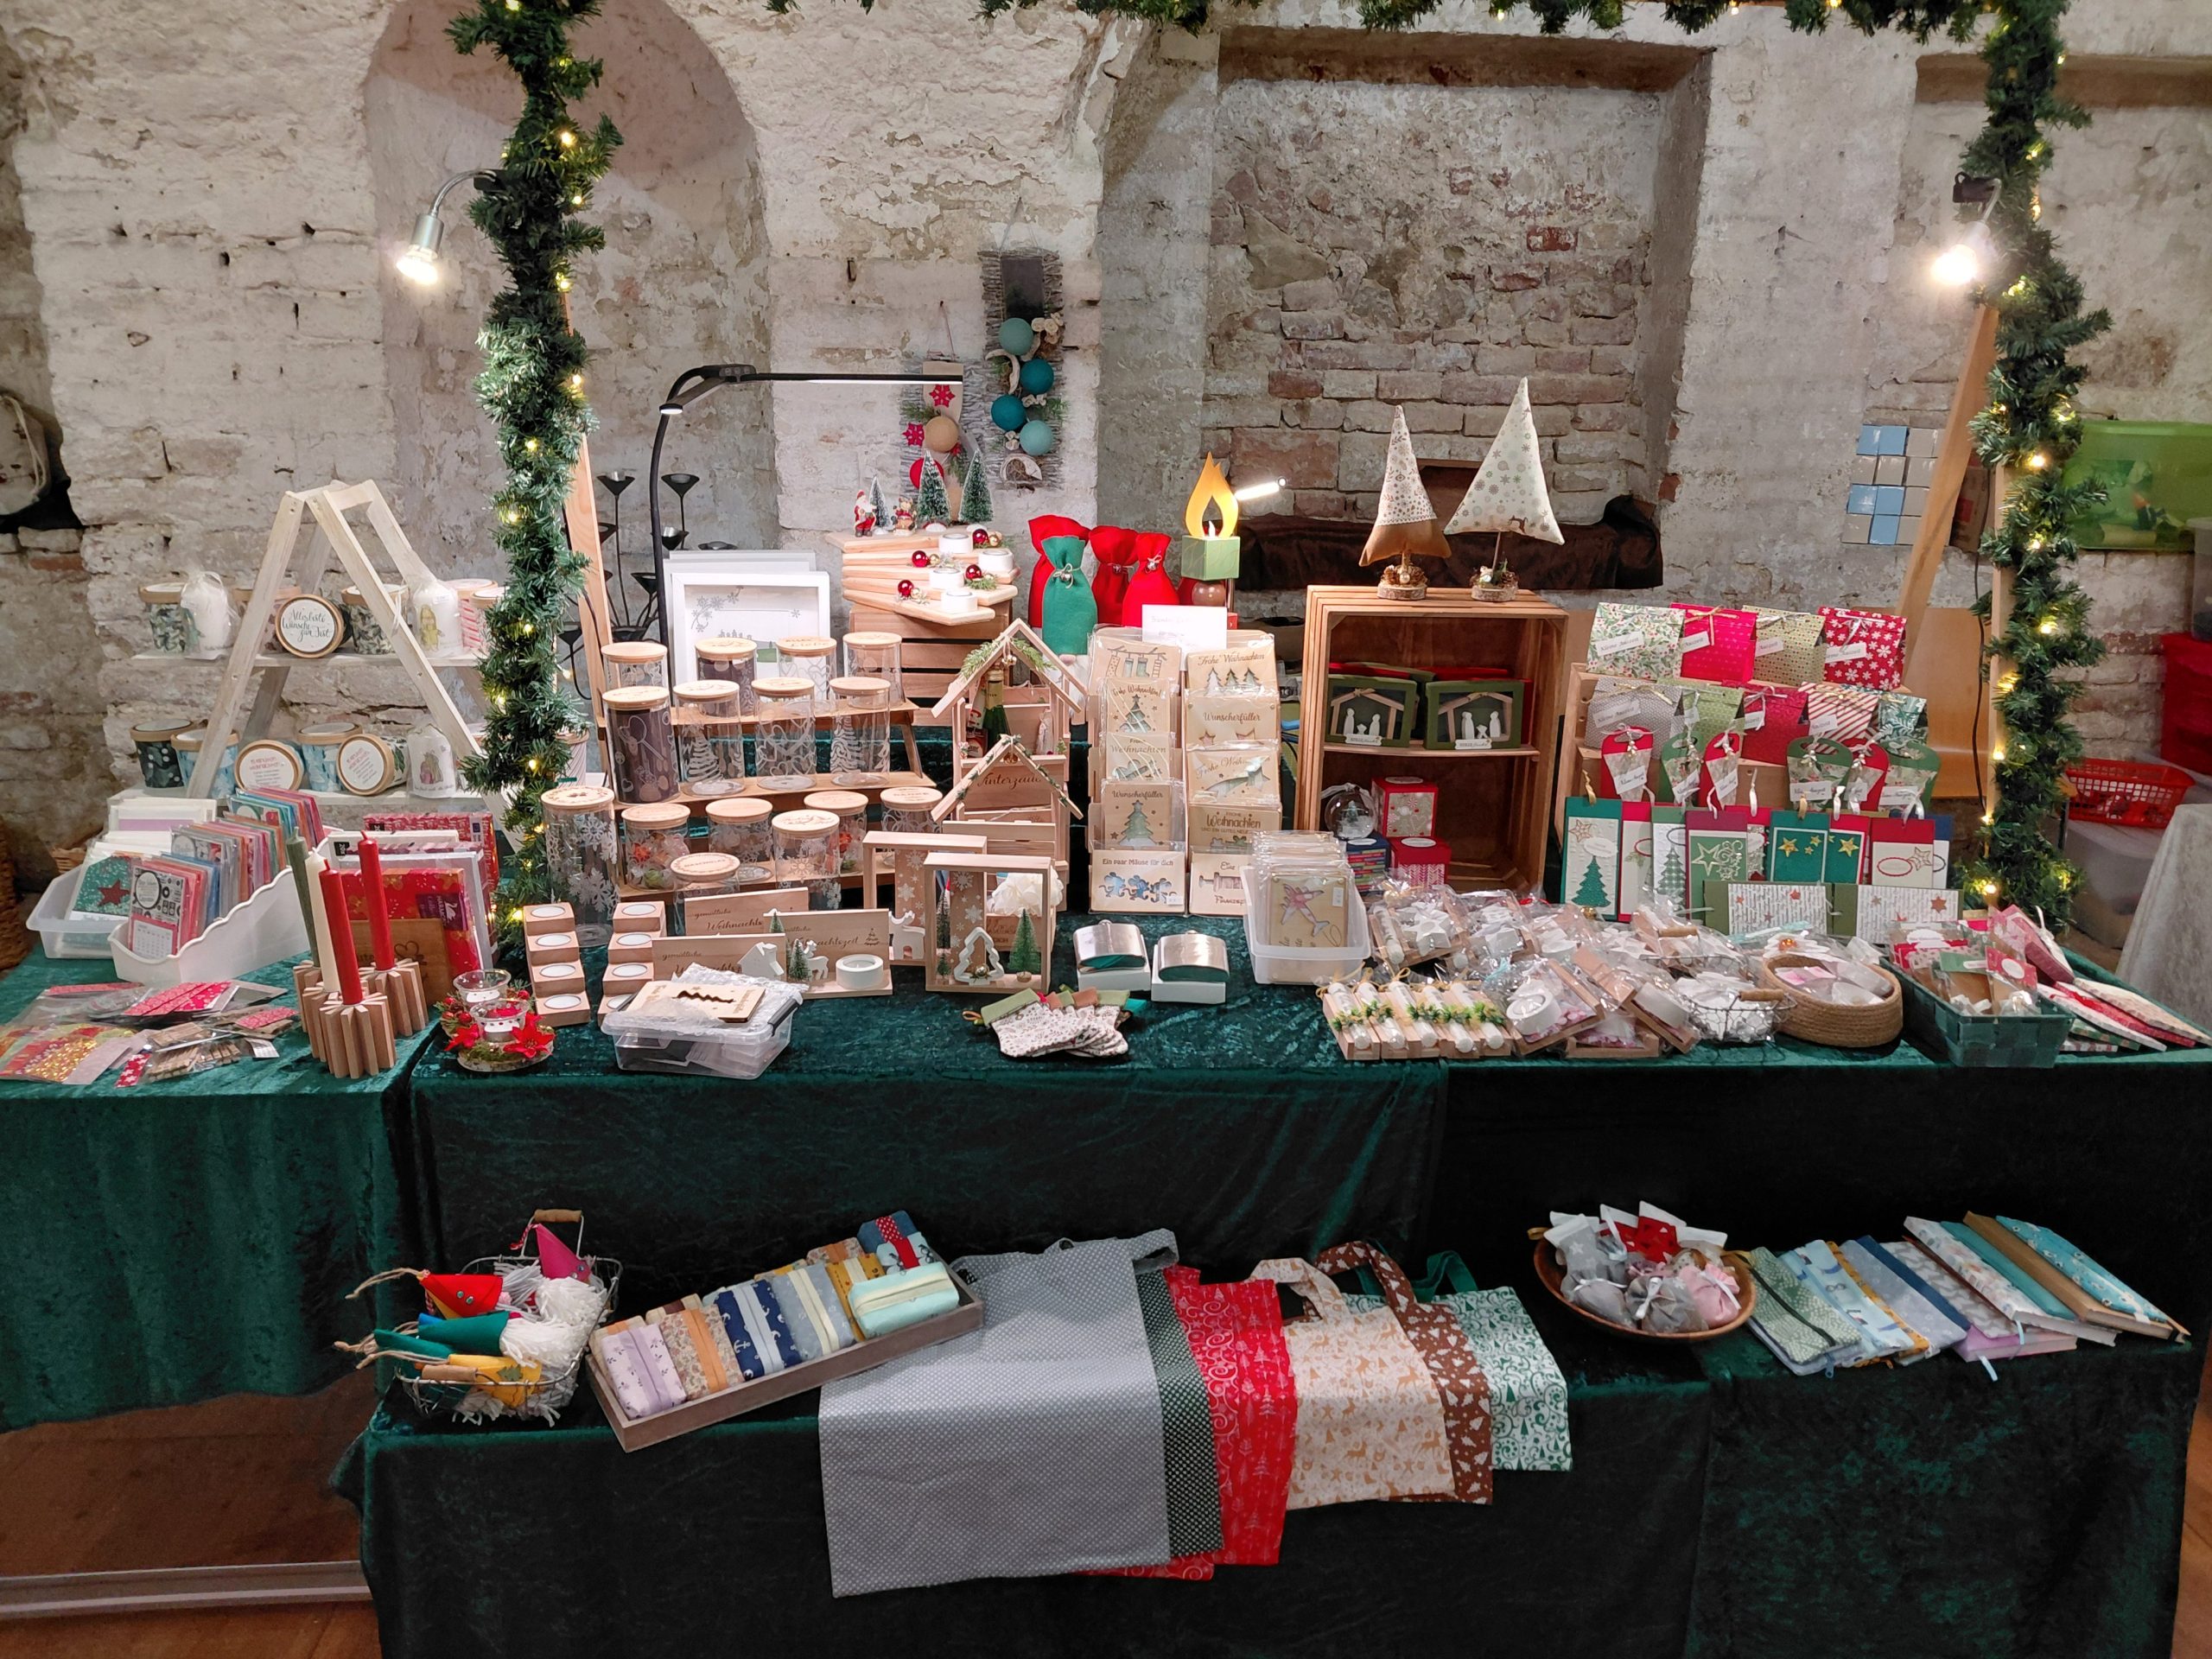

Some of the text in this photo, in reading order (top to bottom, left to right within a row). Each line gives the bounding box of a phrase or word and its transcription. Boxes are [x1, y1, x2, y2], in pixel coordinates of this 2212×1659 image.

[1223, 651, 1265, 664] Weihnachten
[1203, 712, 1262, 724] Wunscherfüller
[1112, 791, 1164, 800] Wunscherfüller
[707, 918, 764, 931] Weihnachts
